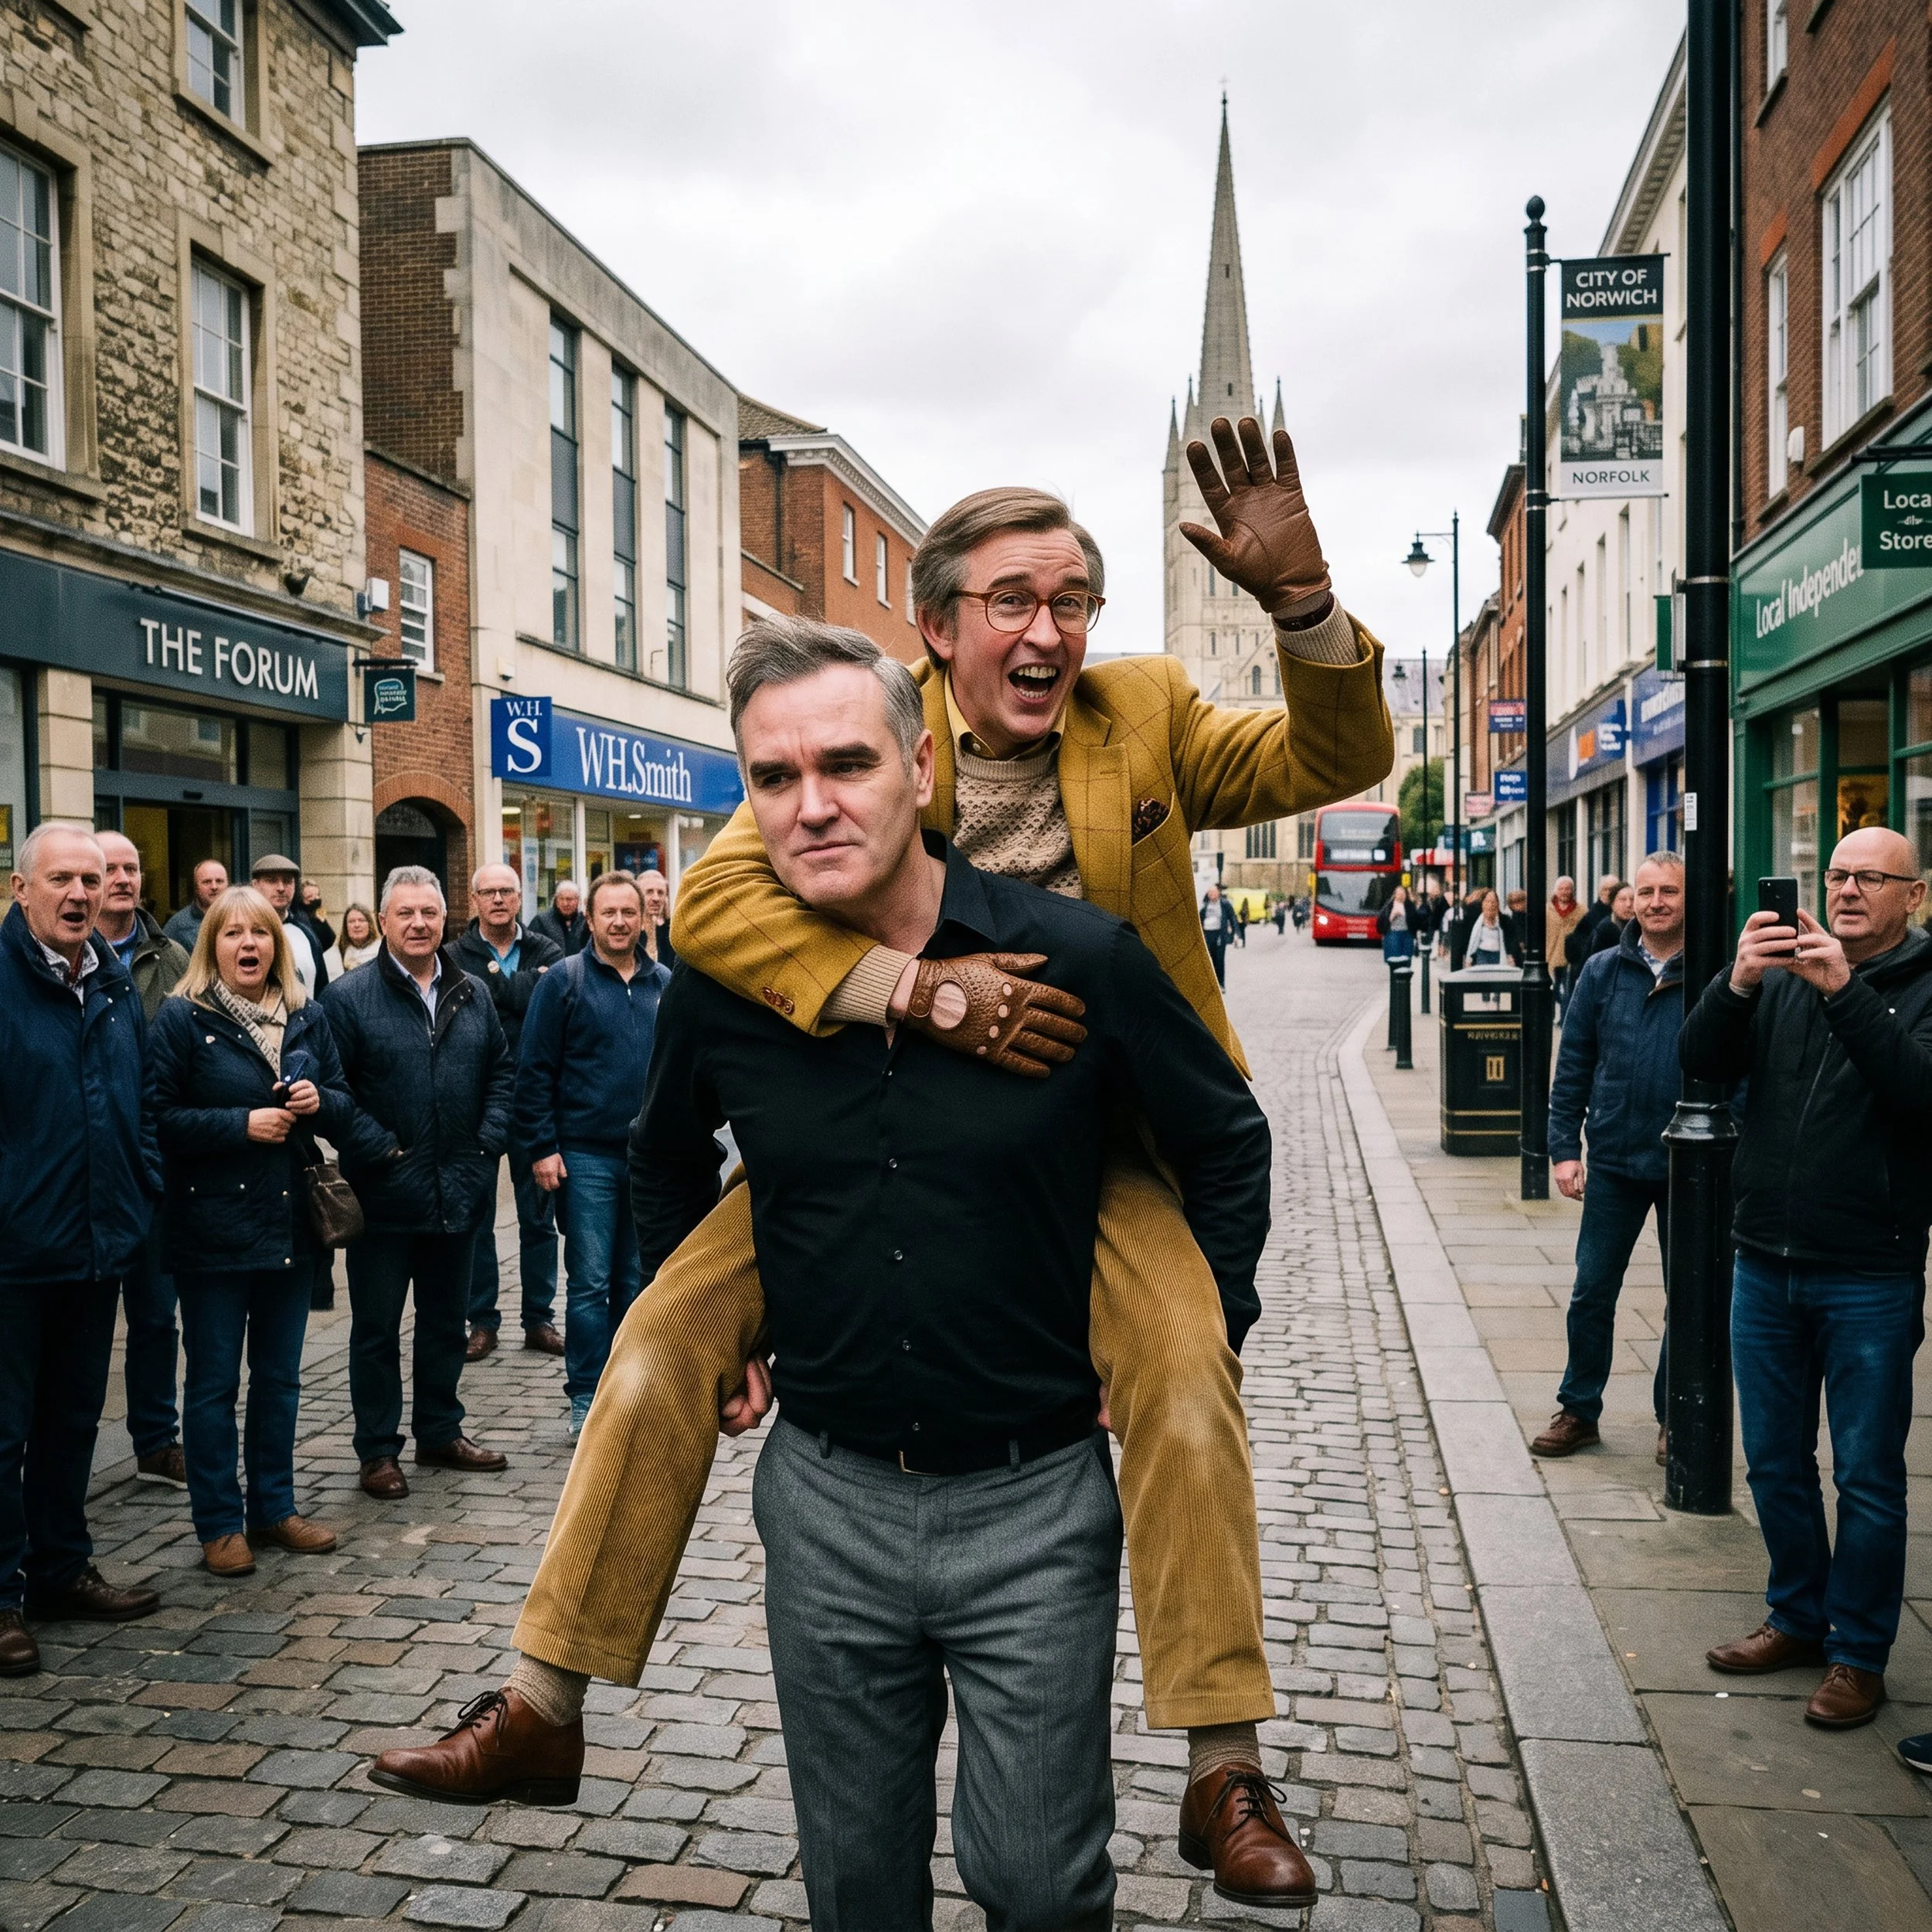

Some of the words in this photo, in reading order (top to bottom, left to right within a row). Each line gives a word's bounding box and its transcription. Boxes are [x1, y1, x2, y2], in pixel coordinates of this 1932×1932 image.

[1575, 270, 1618, 287] CITY
[1621, 268, 1648, 285] OF
[1566, 288, 1658, 308] NORWICH
[1572, 470, 1650, 485] NORFOLK
[1756, 579, 1786, 638] Local
[140, 617, 203, 675] THE
[215, 636, 319, 699] FORUM
[507, 717, 542, 773] S
